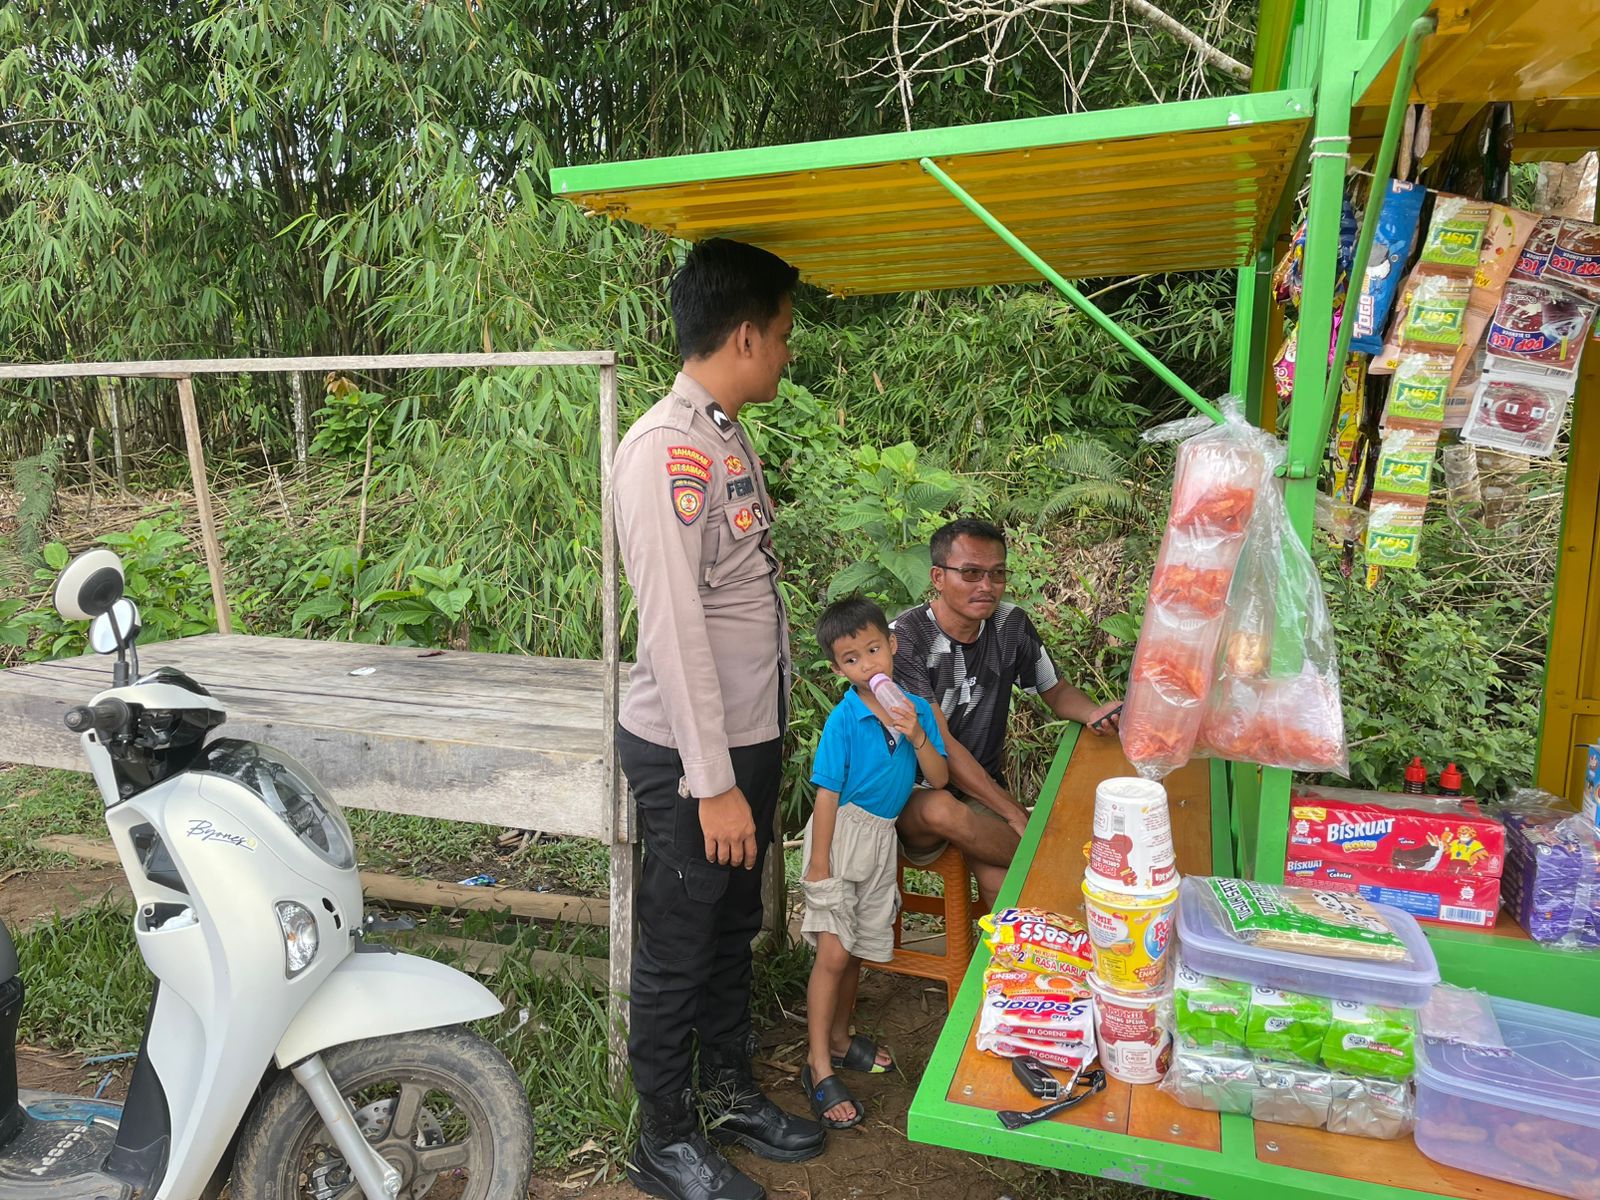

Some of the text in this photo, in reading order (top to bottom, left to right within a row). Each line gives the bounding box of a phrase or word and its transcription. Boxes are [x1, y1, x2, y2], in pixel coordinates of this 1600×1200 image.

[1515, 336, 1545, 351] POP
[1327, 818, 1396, 843] BISKUAT
[1287, 860, 1323, 871] BISKUAT
[1035, 957, 1057, 971] RASA
[1058, 963, 1079, 976] KARI
[992, 1000, 1088, 1016] Sedaap
[1052, 1014, 1074, 1022] Mie
[1027, 1028, 1067, 1038] MI GORENG
[1039, 1052, 1069, 1063] GORENG
